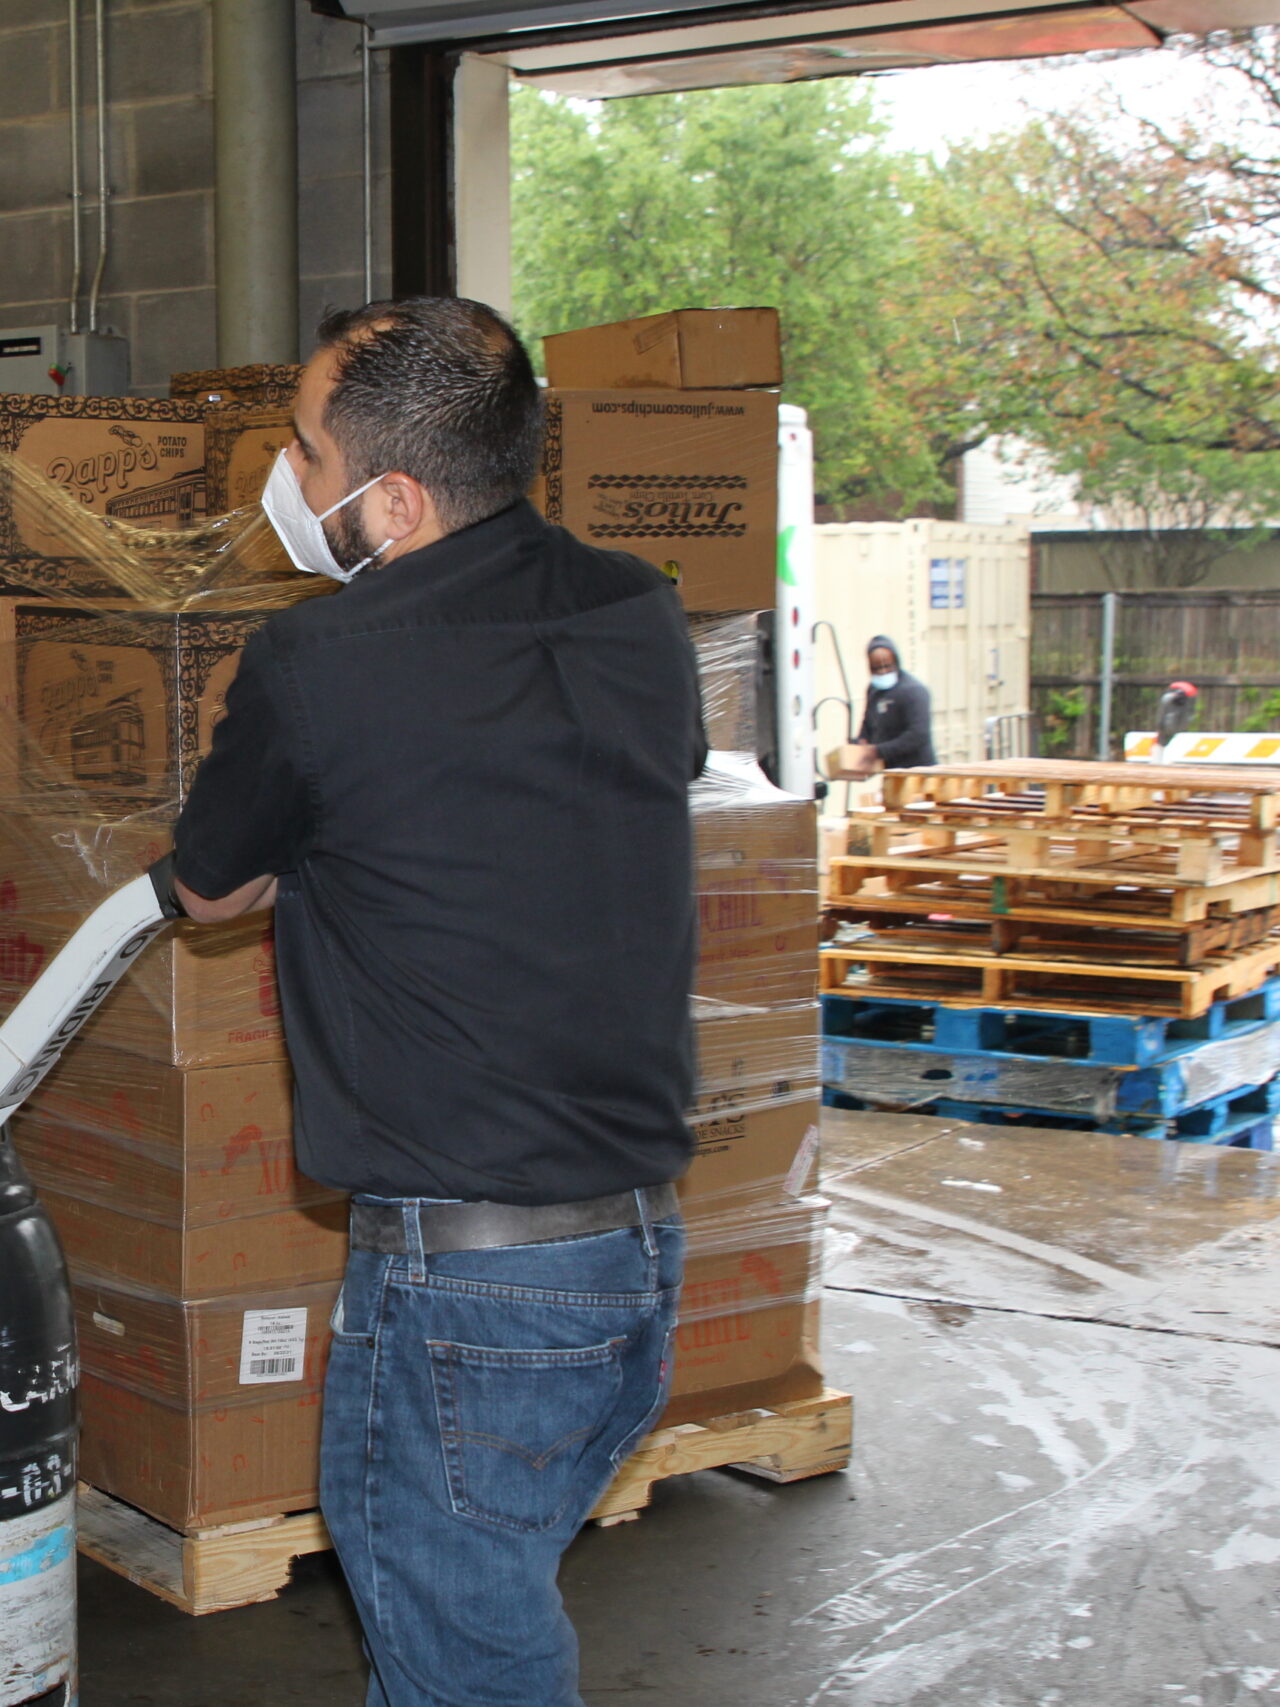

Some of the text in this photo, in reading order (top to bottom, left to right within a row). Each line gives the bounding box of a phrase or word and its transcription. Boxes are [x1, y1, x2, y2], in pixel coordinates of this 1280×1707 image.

[592, 400, 745, 419] www.julioscornchips.com
[157, 435, 187, 447] POTATO
[160, 447, 185, 458] CHIPS
[622, 501, 743, 524] Julio's
[9, 980, 113, 1096] RIDING
